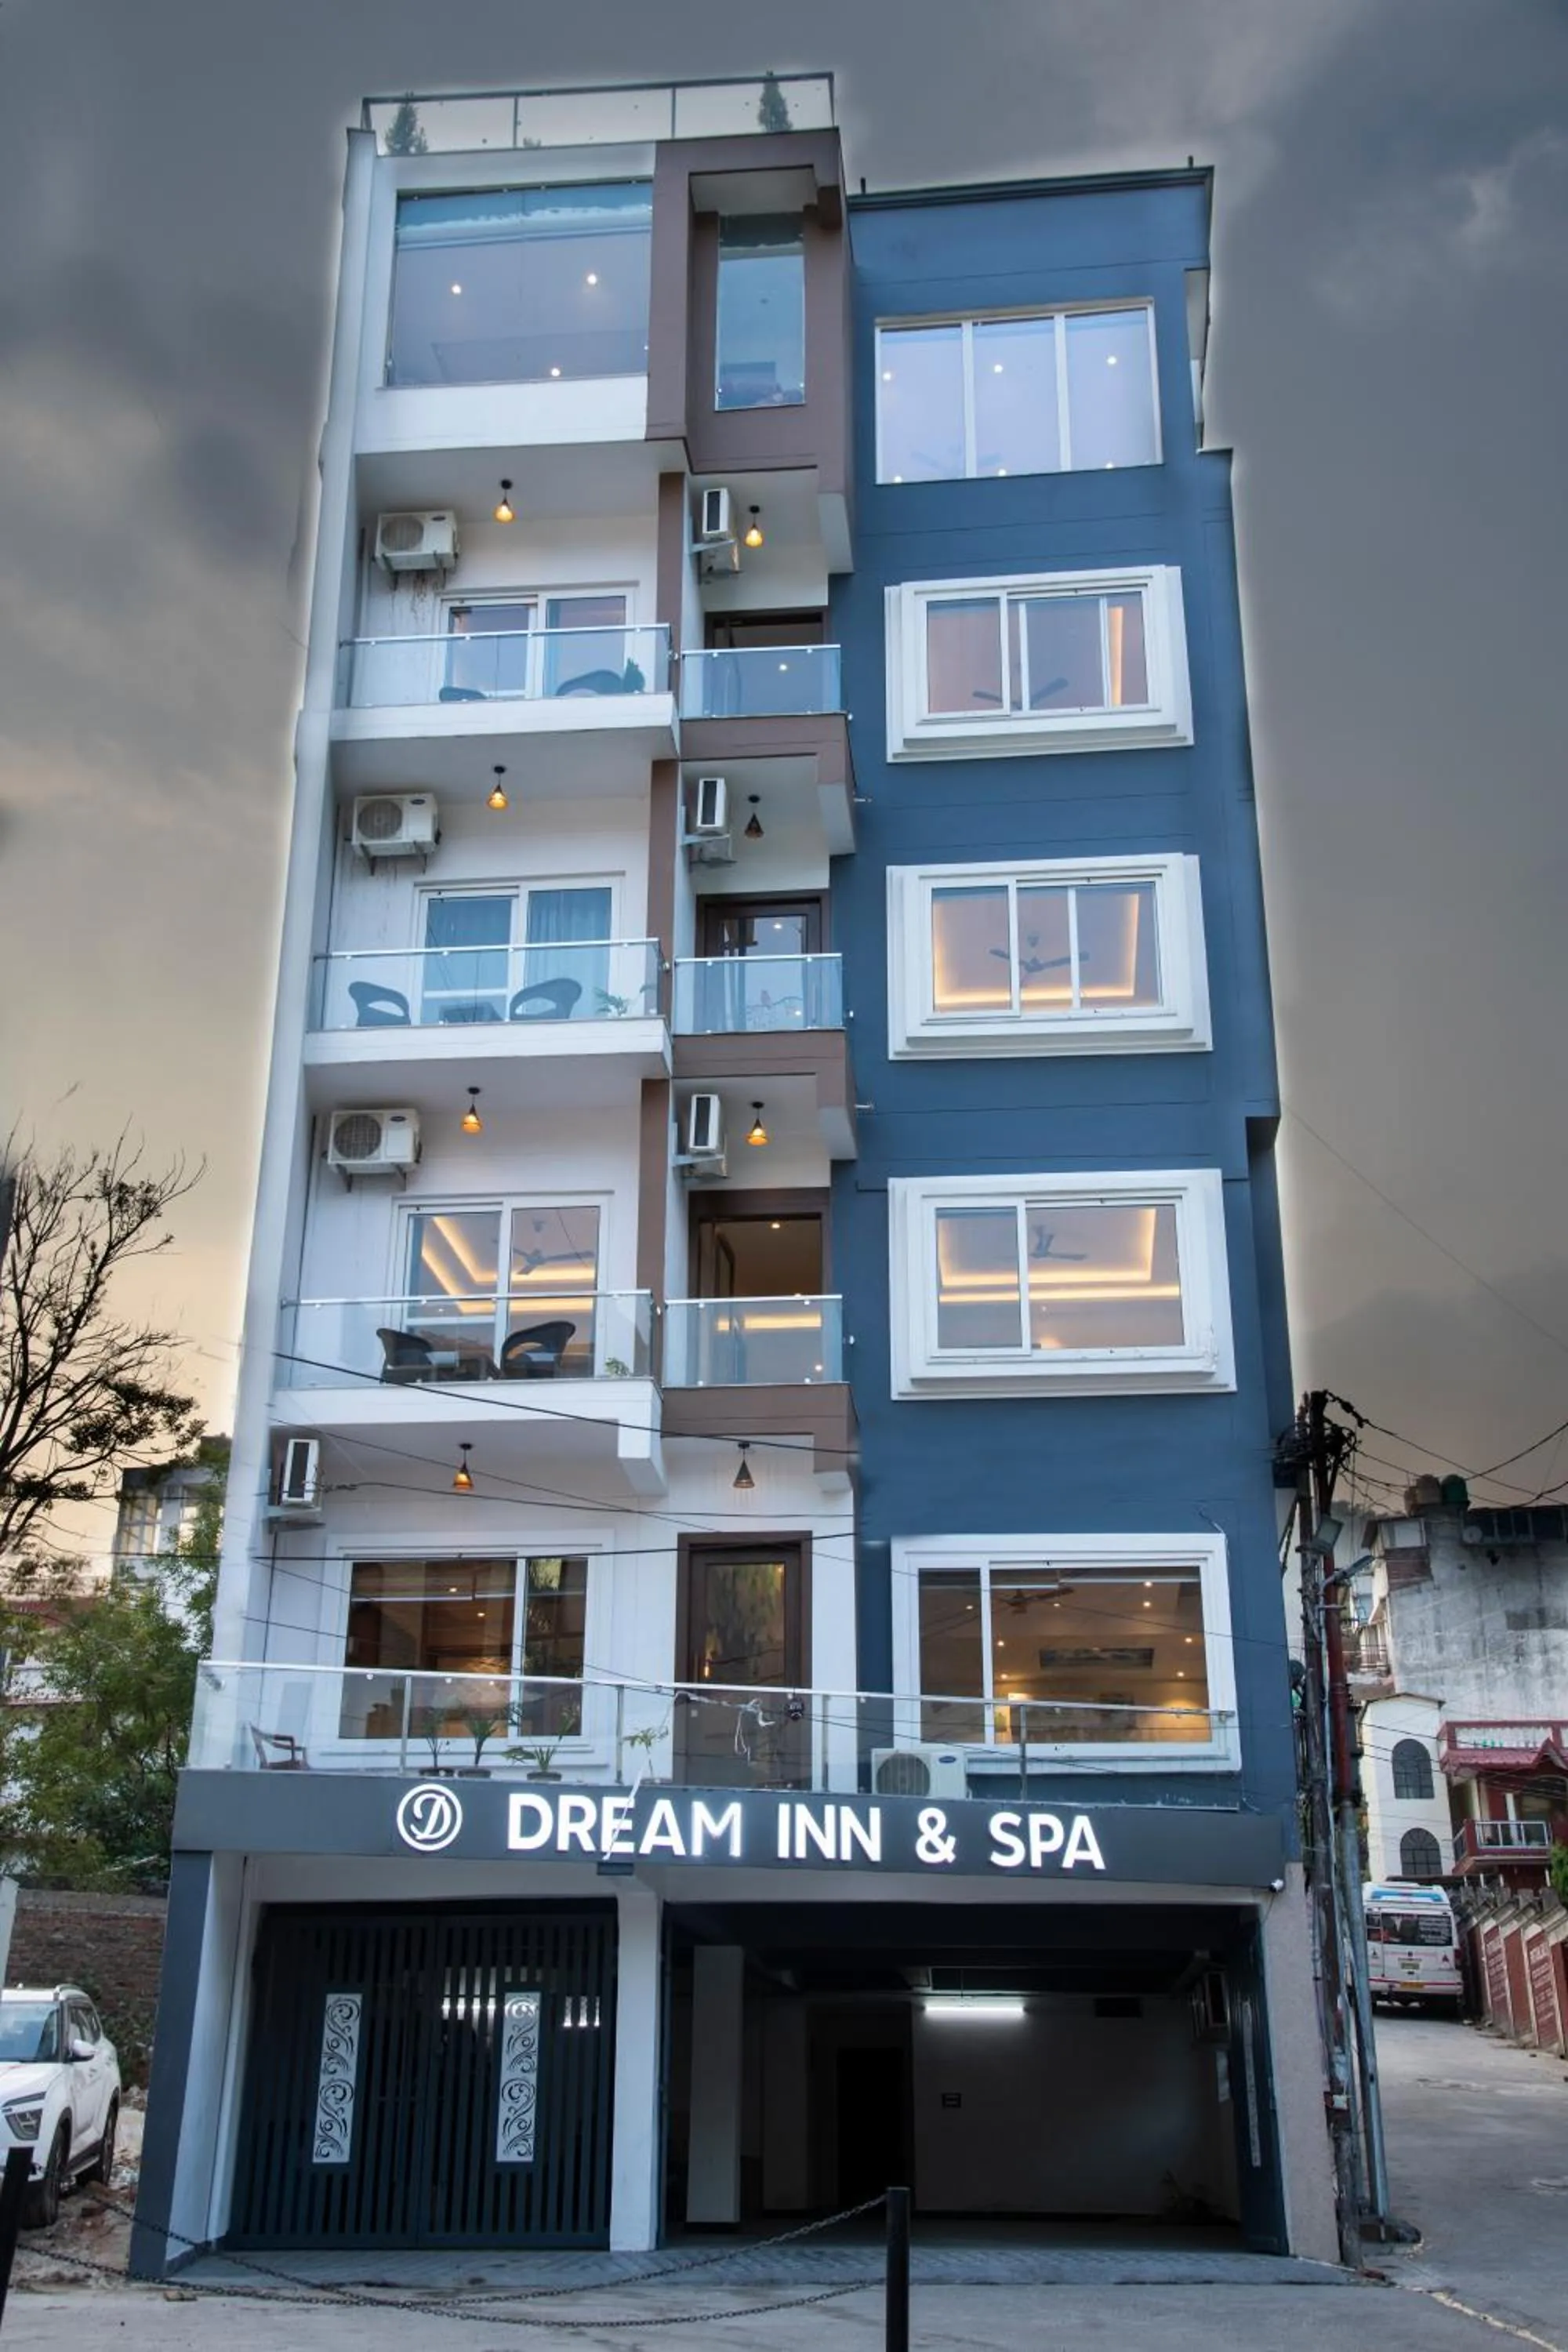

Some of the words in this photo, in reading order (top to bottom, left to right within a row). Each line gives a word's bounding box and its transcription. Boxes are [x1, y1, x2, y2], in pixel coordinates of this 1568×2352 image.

[506, 1792, 742, 1857] DREAM
[777, 1802, 882, 1862] INN
[915, 1806, 956, 1864] &
[989, 1811, 1105, 1871] SPA
